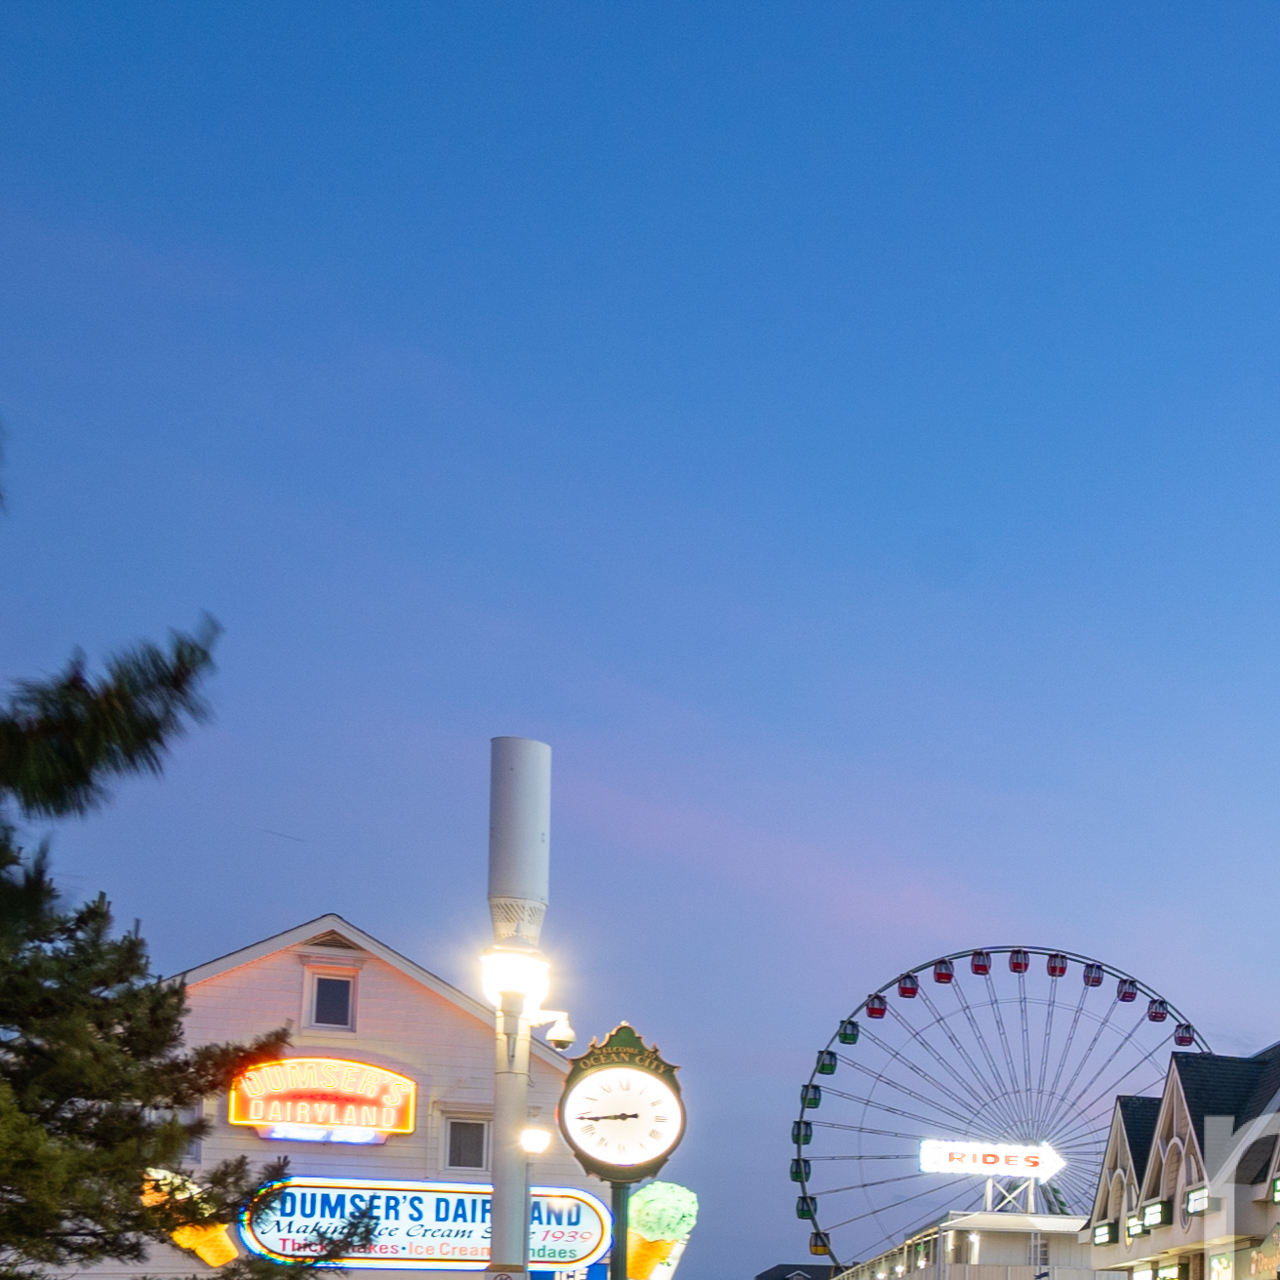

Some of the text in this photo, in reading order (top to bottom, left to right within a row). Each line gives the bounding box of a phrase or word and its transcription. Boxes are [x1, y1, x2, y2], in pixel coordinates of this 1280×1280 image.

[579, 1053, 669, 1074] OCEAN CITY
[241, 1063, 409, 1106] DUMSER'S
[250, 1099, 396, 1127] DAIRYLAND
[948, 1151, 1040, 1168] RIDES
[280, 1191, 581, 1226] DUMSER'S DAIRAND
[261, 1219, 354, 1236] Makin
[406, 1223, 474, 1239] Cream
[541, 1229, 593, 1243] 1939
[408, 1241, 435, 1255] Ice
